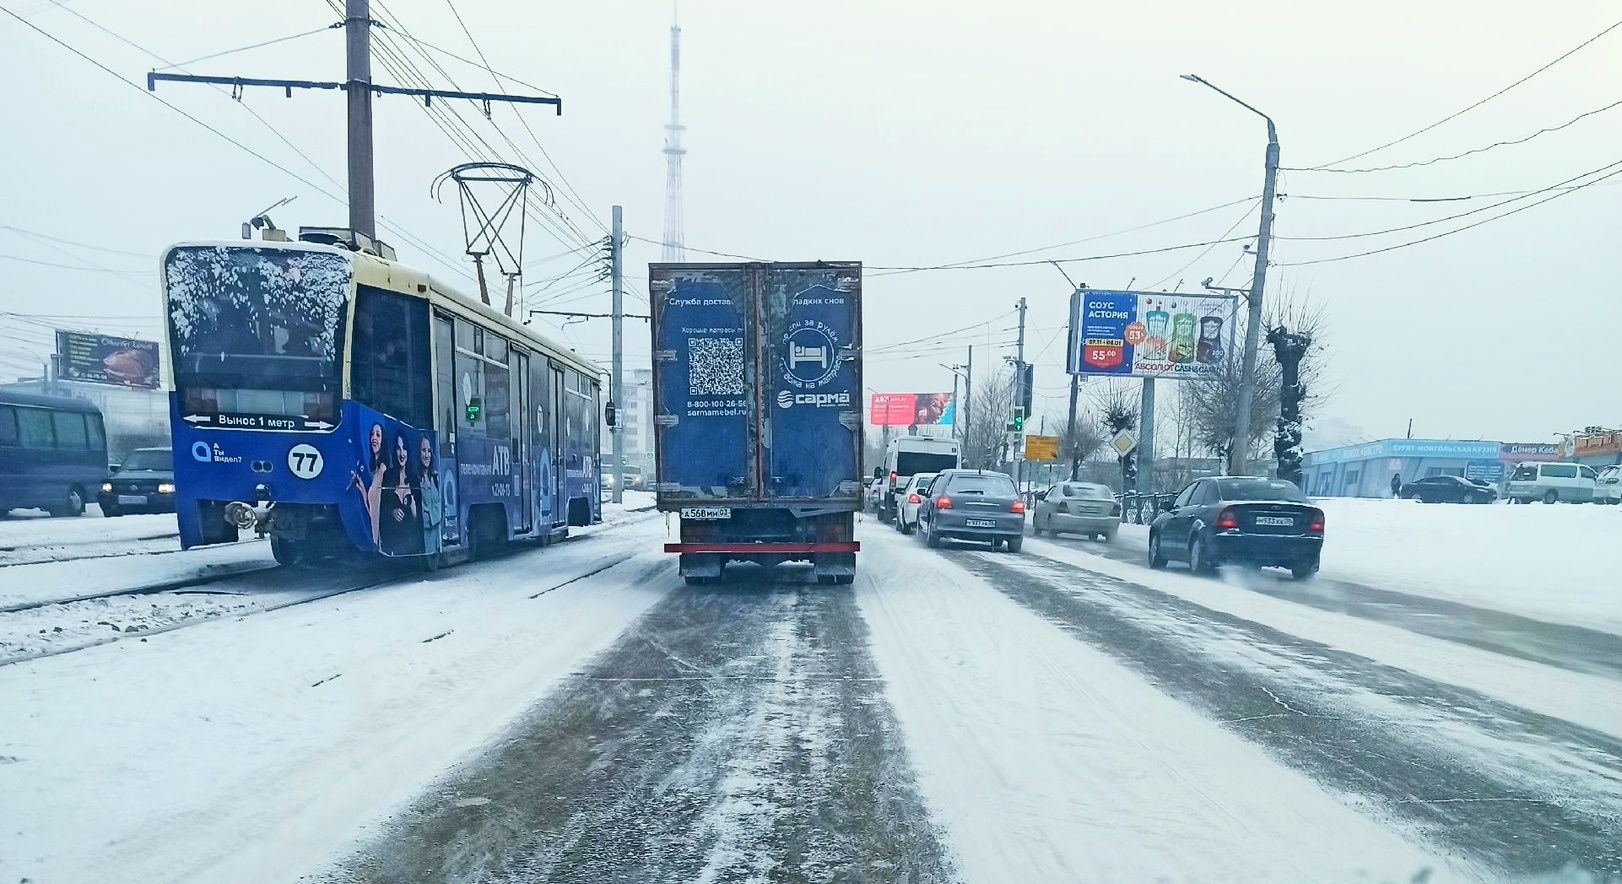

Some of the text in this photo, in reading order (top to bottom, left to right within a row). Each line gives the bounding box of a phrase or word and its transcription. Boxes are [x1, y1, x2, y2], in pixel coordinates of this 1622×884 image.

[669, 297, 735, 308] Служба достав
[1088, 301, 1115, 310] СОУС
[1087, 309, 1129, 320] АСТОРИЯ
[687, 408, 747, 417] sarmamebel.ru
[218, 414, 295, 429] Вынос 1 метр
[213, 455, 243, 464] Видел?
[292, 452, 318, 473] 77
[492, 445, 510, 476] АТВ
